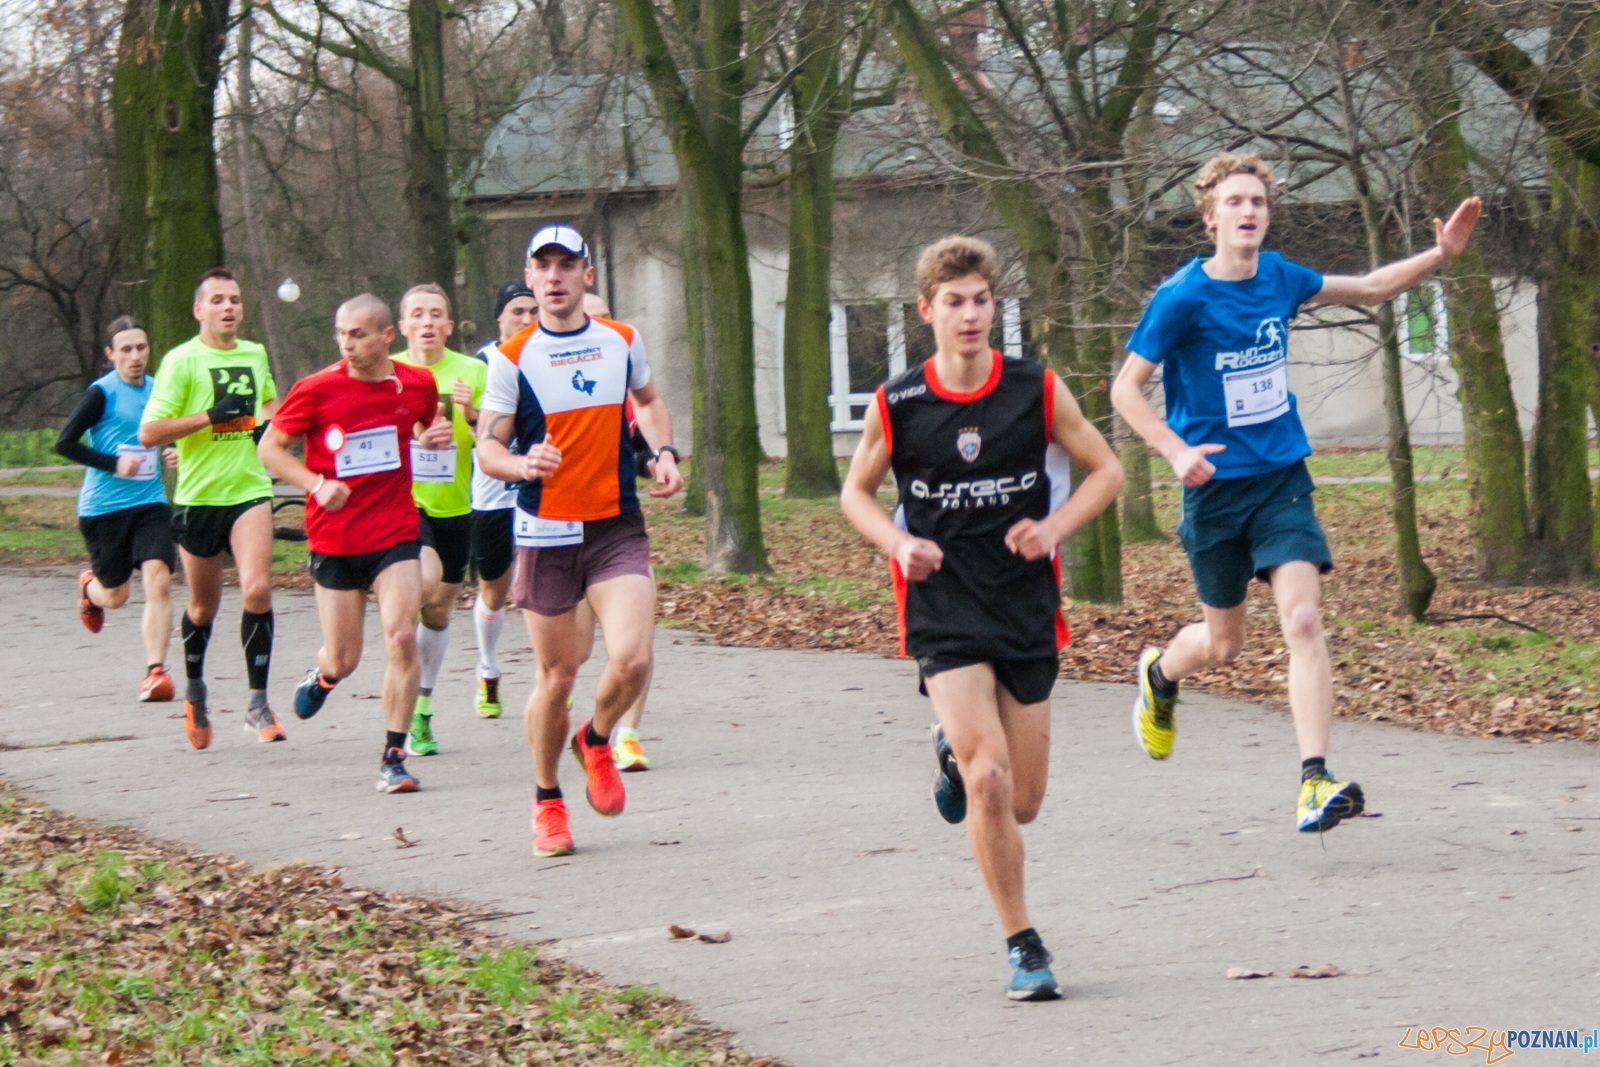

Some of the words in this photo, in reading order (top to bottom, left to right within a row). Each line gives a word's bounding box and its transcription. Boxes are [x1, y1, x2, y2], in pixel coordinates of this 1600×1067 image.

[550, 352, 604, 367] BIEGACZE
[1252, 378, 1273, 394] 138
[360, 440, 373, 450] 41
[419, 452, 438, 462] 513
[941, 494, 1010, 509] POLAND
